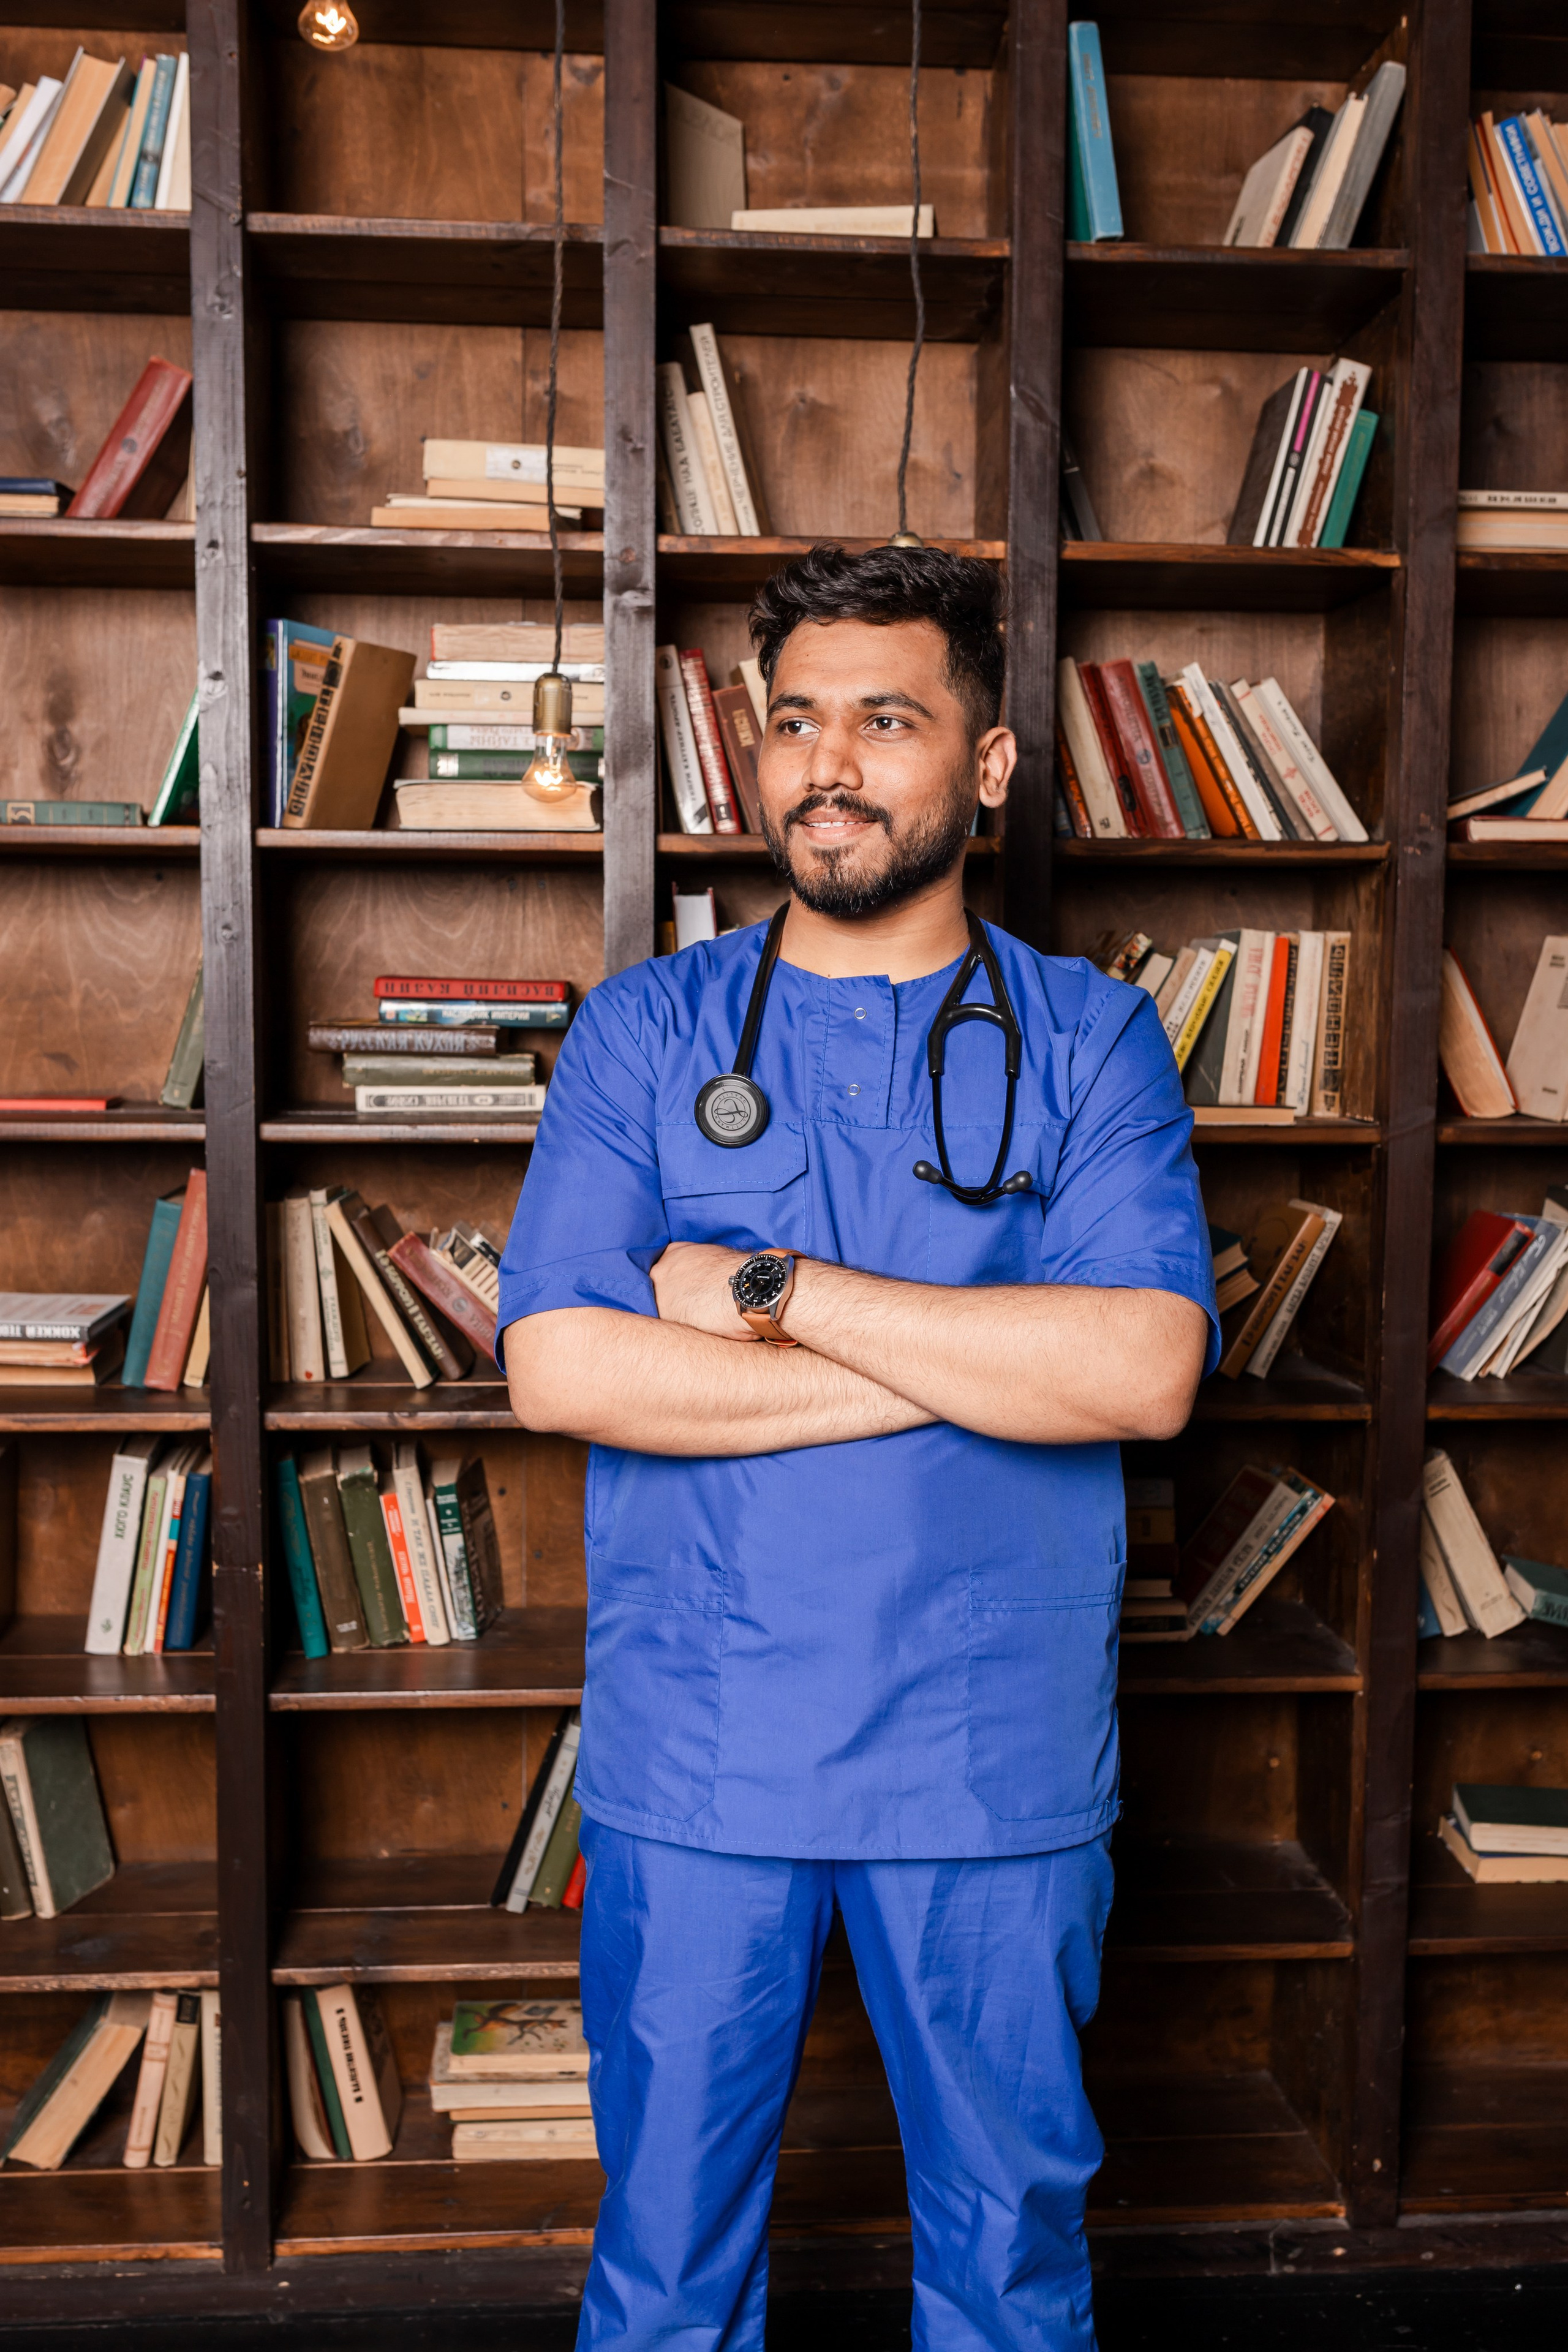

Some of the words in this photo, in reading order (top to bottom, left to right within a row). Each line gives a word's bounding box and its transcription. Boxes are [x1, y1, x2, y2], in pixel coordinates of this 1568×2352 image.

[1502, 123, 1540, 196] СОВЕТНИКИ
[1530, 195, 1544, 208] И
[1534, 206, 1561, 254] ВОЖДИ
[699, 334, 726, 412] СТРОИТЕЛЕЙ
[716, 412, 733, 439] ДЛЯ
[677, 457, 694, 485] НАД
[725, 441, 747, 504] ЧЕРЧЕНИЕ
[384, 981, 450, 995] КАЗИН
[463, 982, 554, 999] ВАСИЛИЙ
[491, 1010, 530, 1020] ИМПЕРИИ
[341, 1029, 408, 1050] РУССКАЯ
[413, 1030, 467, 1051] КУХНЯ
[718, 1093, 746, 1102] QUALITY
[715, 1116, 747, 1129] LITTMANN
[24, 1324, 80, 1340] ХОККЕЙ
[118, 1473, 134, 1508] КЛАУС
[114, 1509, 128, 1539] ХЮГО
